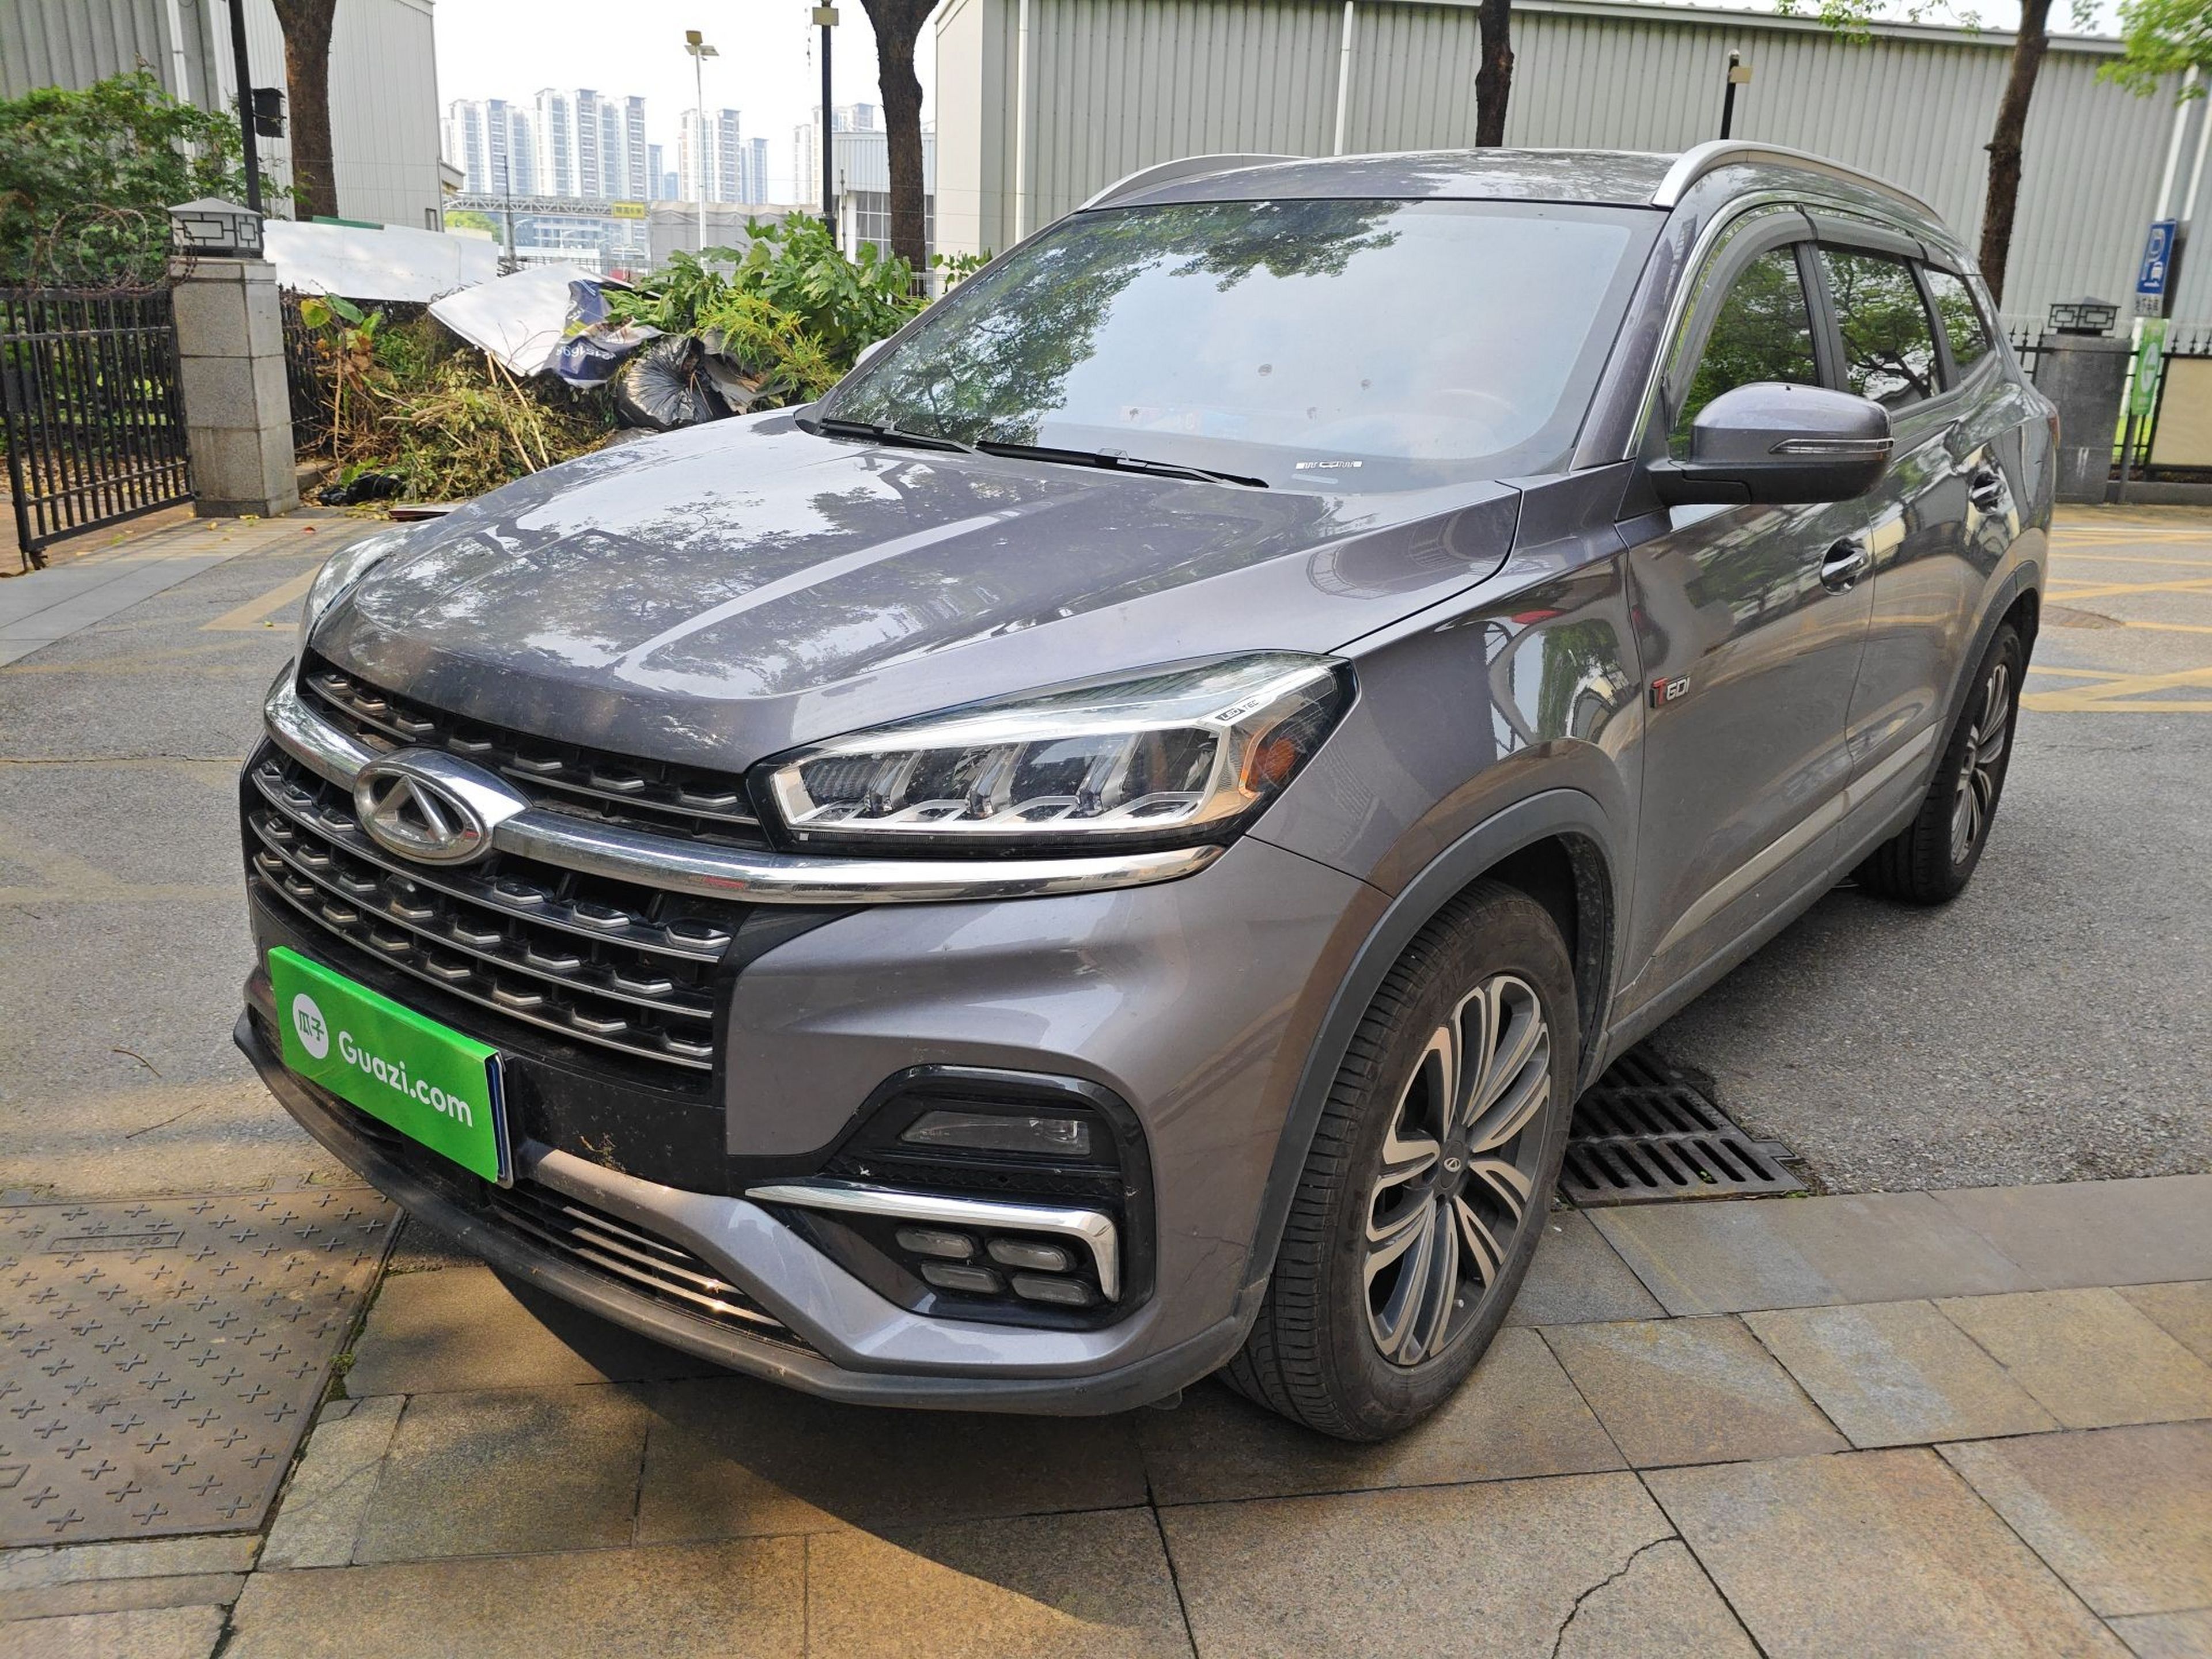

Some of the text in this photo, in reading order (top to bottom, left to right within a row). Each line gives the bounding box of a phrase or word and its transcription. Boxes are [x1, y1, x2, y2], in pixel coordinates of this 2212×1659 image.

[1220, 709, 1242, 721] LED
[298, 1009, 324, 1041] 瓜子
[339, 1031, 473, 1127] Guazi.com
